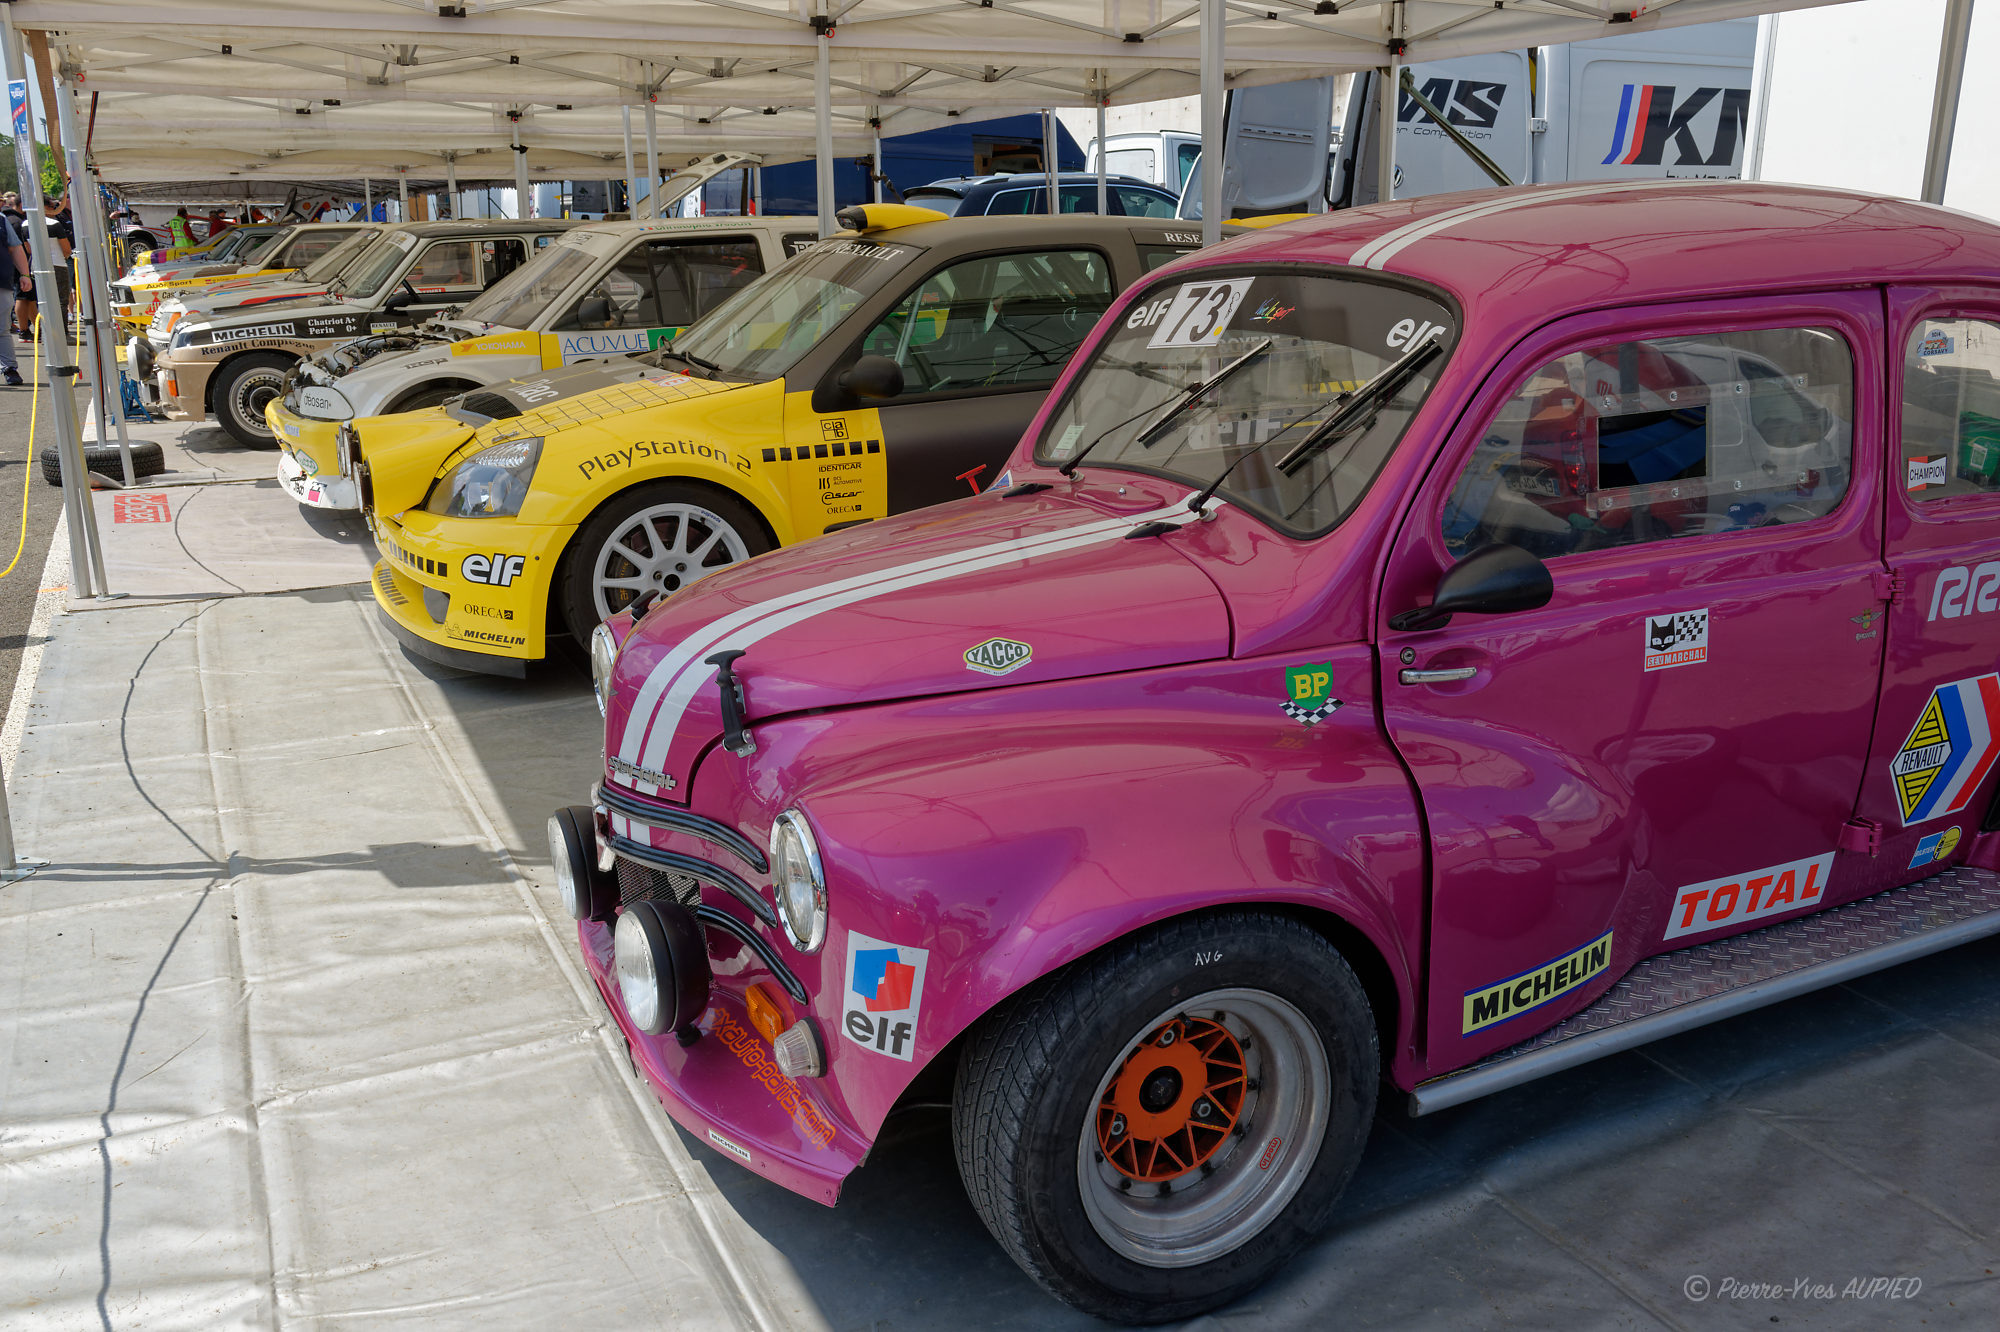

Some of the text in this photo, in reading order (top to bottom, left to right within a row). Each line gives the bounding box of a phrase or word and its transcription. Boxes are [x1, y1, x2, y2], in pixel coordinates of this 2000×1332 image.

[308, 318, 344, 327] Chatriot
[1127, 298, 1172, 329] elf
[1165, 284, 1232, 342] 73
[214, 324, 293, 341] MICHELIN
[309, 326, 335, 335] Perin
[1386, 319, 1447, 354] elf
[201, 342, 247, 356] Renault
[476, 341, 526, 351] YOKOHAMA
[563, 333, 648, 353] ACUVUE
[578, 440, 727, 481] PlayStation
[818, 462, 862, 472] IDENTICAR
[1909, 466, 1945, 481] CHAMPION
[827, 505, 856, 515] ORECA
[461, 553, 525, 587] elf
[464, 603, 504, 620] ORECA
[463, 629, 526, 645] MICHELIN
[971, 641, 1024, 666] YACCO
[1664, 648, 1705, 665] MARCHAL
[1293, 672, 1329, 700] BP
[1901, 744, 1945, 772] RENAULT
[1679, 863, 1821, 929] TOTAL
[1471, 940, 1607, 1024] MICHELIN
[846, 1009, 912, 1056] elf
[711, 1133, 749, 1158] MICHELIN
